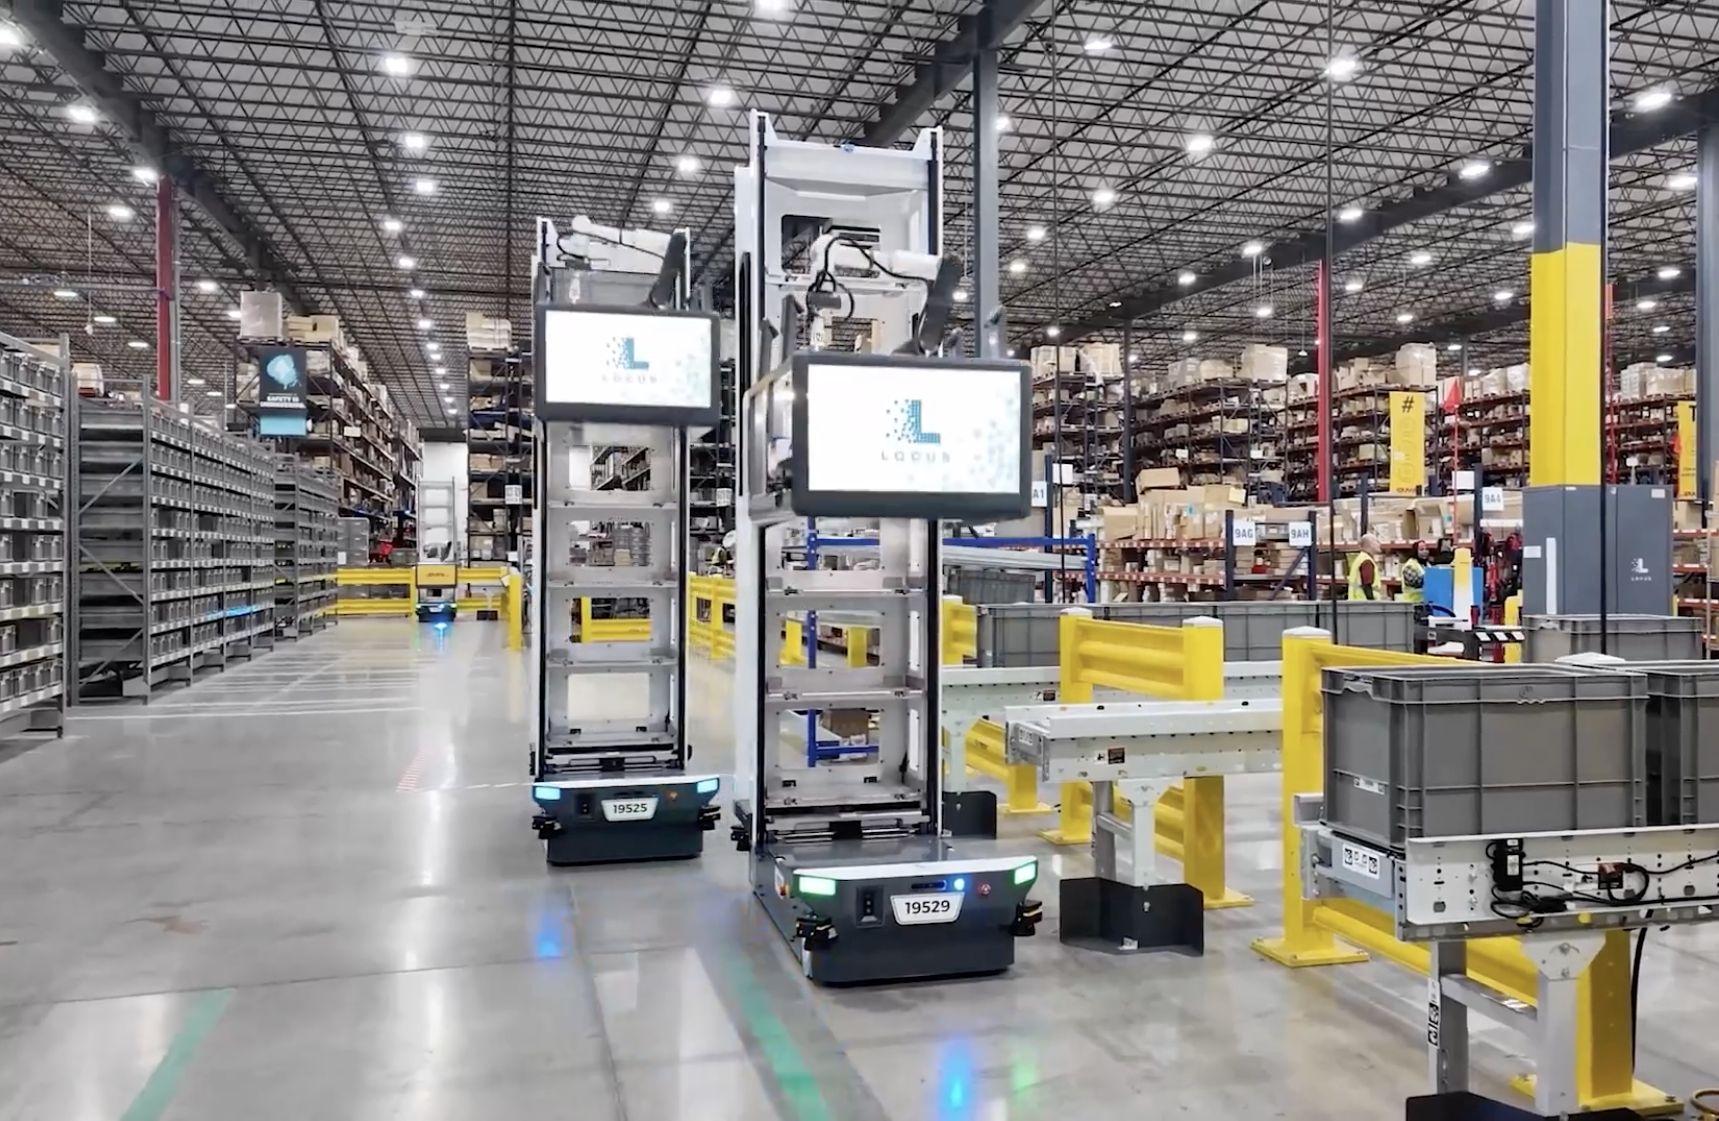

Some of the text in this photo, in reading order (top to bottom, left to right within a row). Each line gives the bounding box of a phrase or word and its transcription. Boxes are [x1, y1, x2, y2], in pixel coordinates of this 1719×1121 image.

[1032, 489, 1044, 499] A1
[1234, 528, 1253, 538] 9AG
[1291, 529, 1309, 539] 9AH
[613, 803, 648, 814] 19525
[905, 899, 950, 914] 19529
